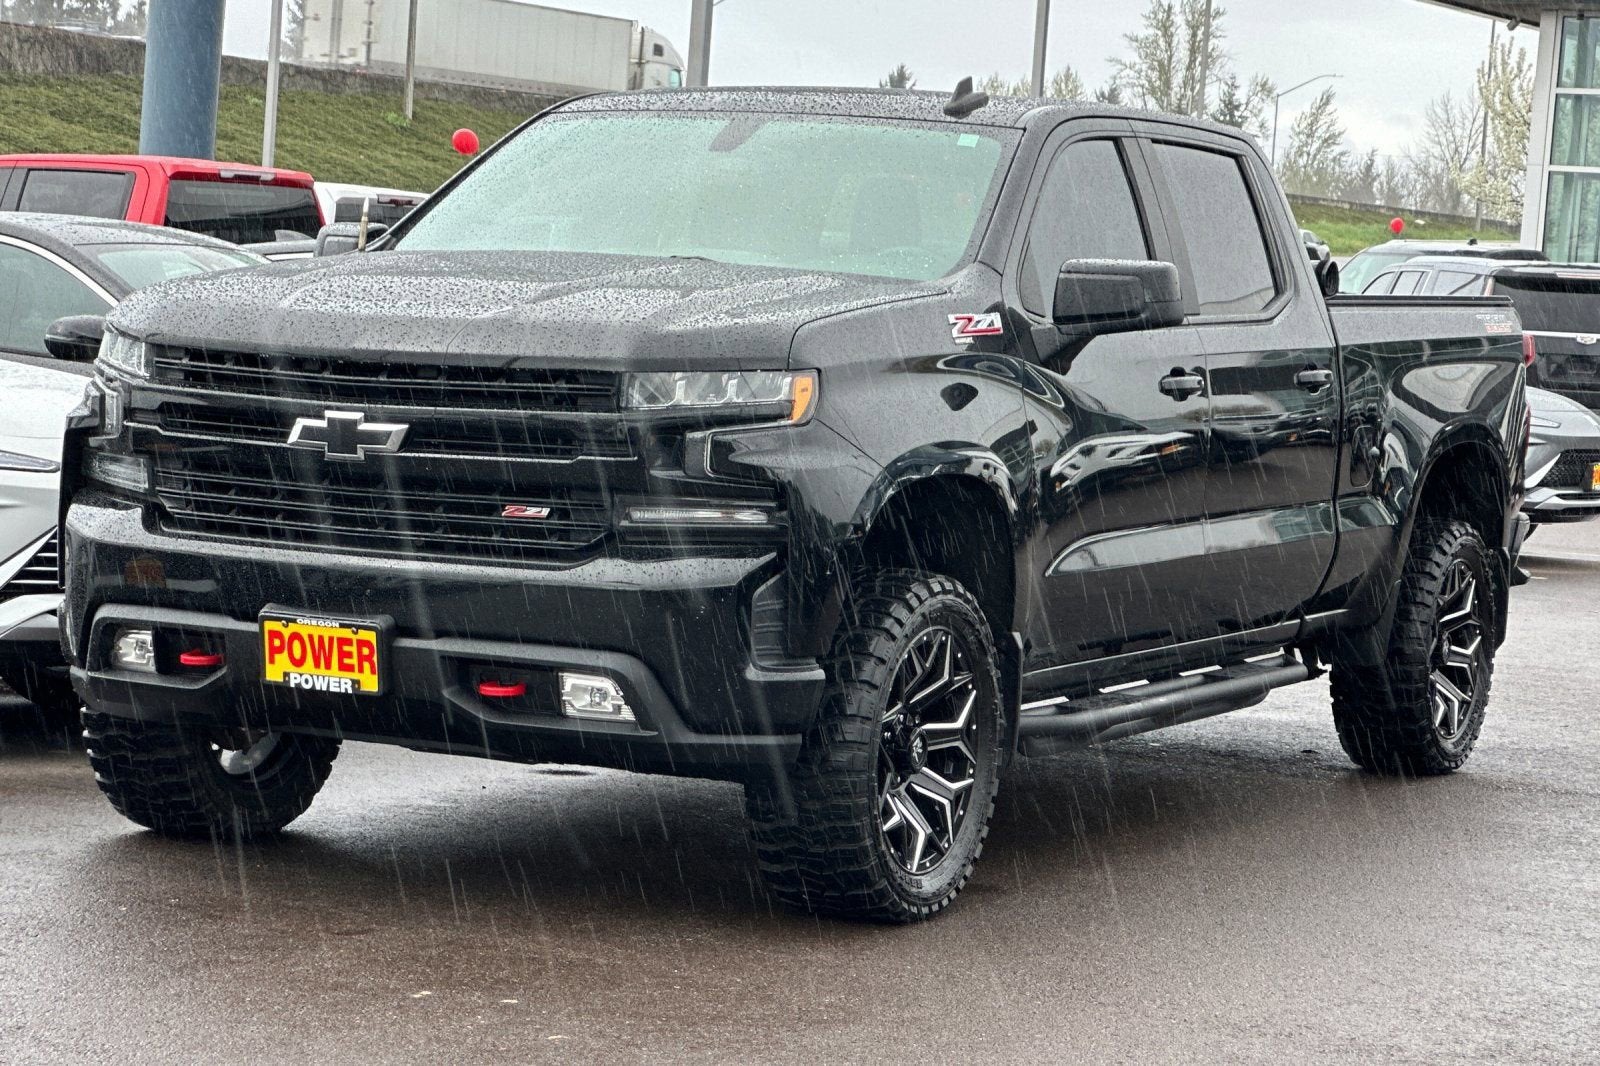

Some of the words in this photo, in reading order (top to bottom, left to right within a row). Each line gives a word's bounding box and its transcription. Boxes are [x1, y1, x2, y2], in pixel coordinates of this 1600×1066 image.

[948, 312, 1004, 338] Z71
[501, 505, 551, 518] Z71
[296, 618, 340, 628] OREGON
[267, 629, 377, 676] POWER
[289, 672, 353, 694] POWER
